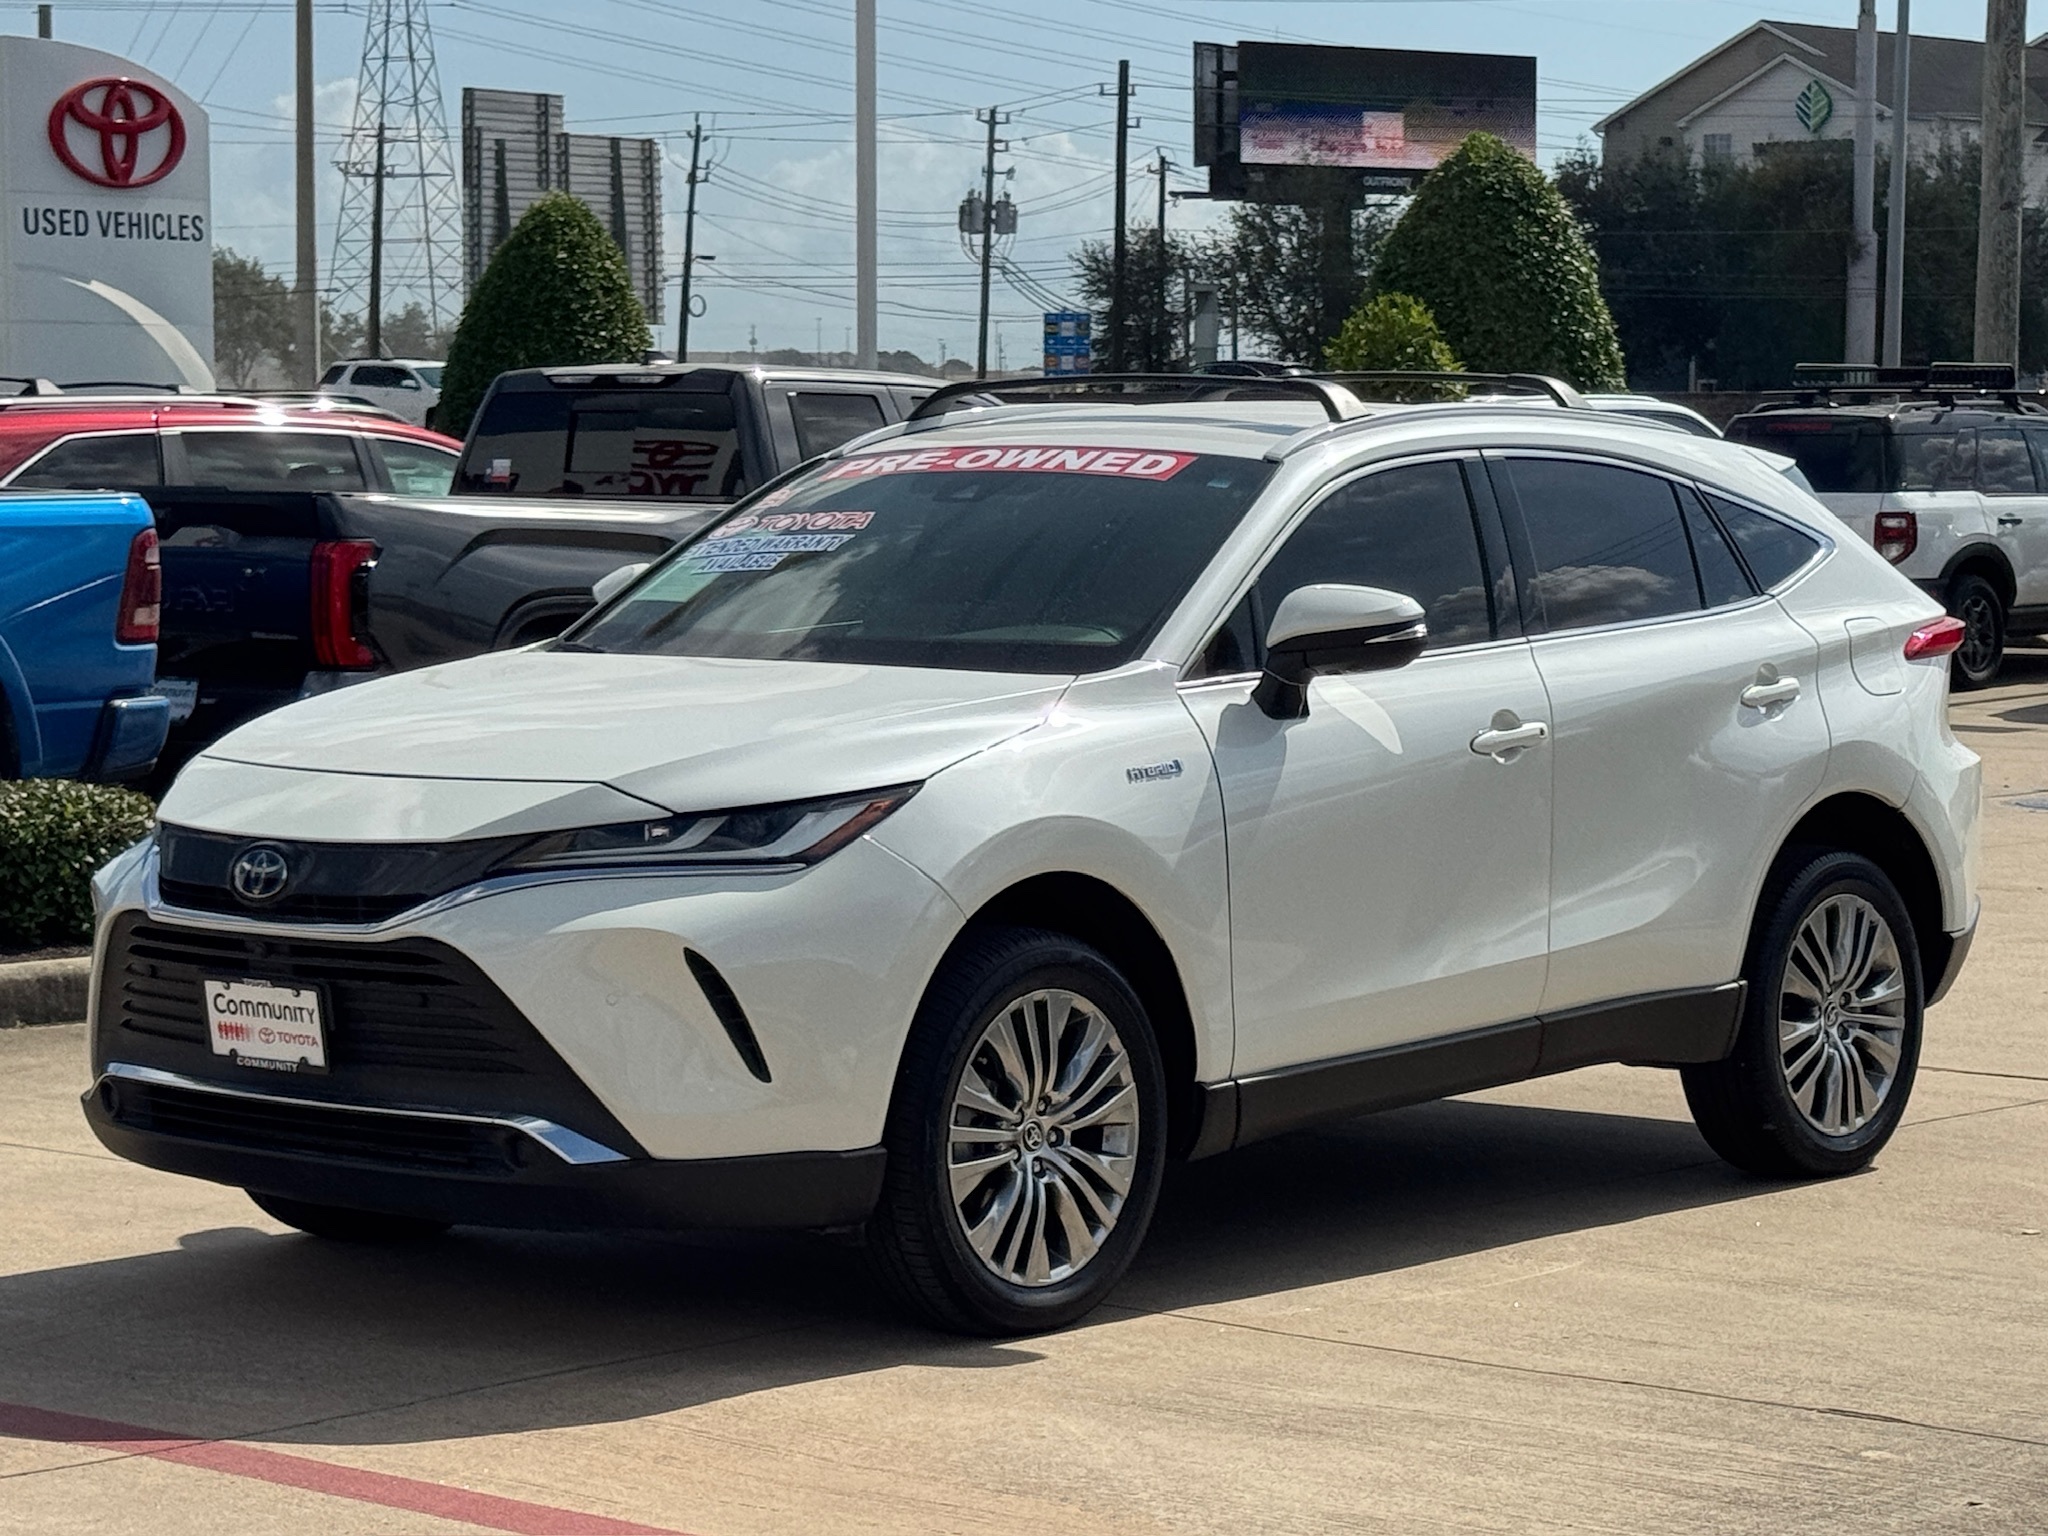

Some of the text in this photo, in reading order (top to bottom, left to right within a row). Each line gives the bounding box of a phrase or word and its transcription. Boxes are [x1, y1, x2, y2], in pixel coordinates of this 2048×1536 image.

[23, 207, 204, 242] USED VEHICLES
[827, 448, 1178, 479] PRE-OWNED
[756, 512, 874, 531] TOYOTA
[758, 535, 853, 551] WARRANTY
[698, 553, 782, 571] AVAILABLE
[276, 1031, 318, 1047] TOYOTA
[237, 1056, 299, 1073] COMMUNITY
